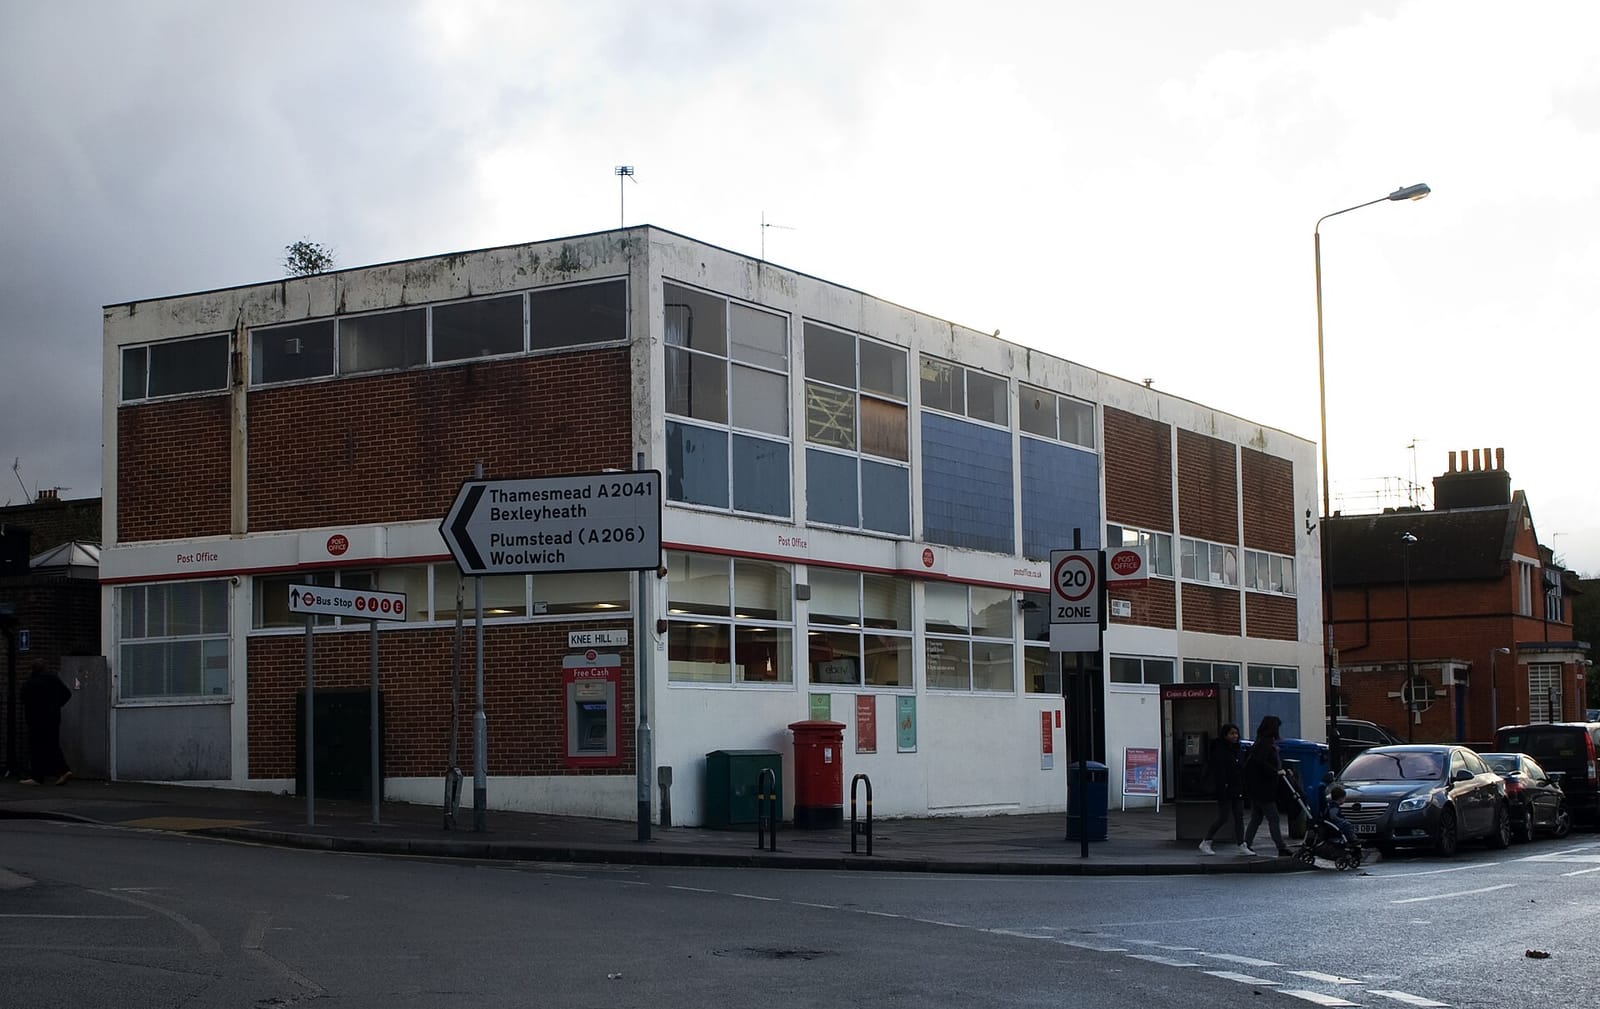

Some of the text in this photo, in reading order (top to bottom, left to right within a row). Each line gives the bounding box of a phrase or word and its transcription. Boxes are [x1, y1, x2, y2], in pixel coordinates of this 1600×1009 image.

[489, 481, 652, 503] Thamesmead A2041
[490, 503, 587, 522] Bexleyheath
[490, 525, 646, 547] Plumstead (A206)
[778, 535, 807, 549] Post Office
[177, 551, 218, 564] Post Office
[490, 549, 565, 566] Woolwich
[1117, 555, 1135, 563] POST
[1114, 561, 1138, 570] OFFICE
[1062, 570, 1087, 587] 20
[316, 596, 331, 605] Bus
[333, 597, 353, 608] Stop
[1057, 606, 1091, 618] ZONE
[571, 634, 591, 645] KNEE
[595, 633, 612, 643] HILL
[573, 667, 609, 677] Free Cash
